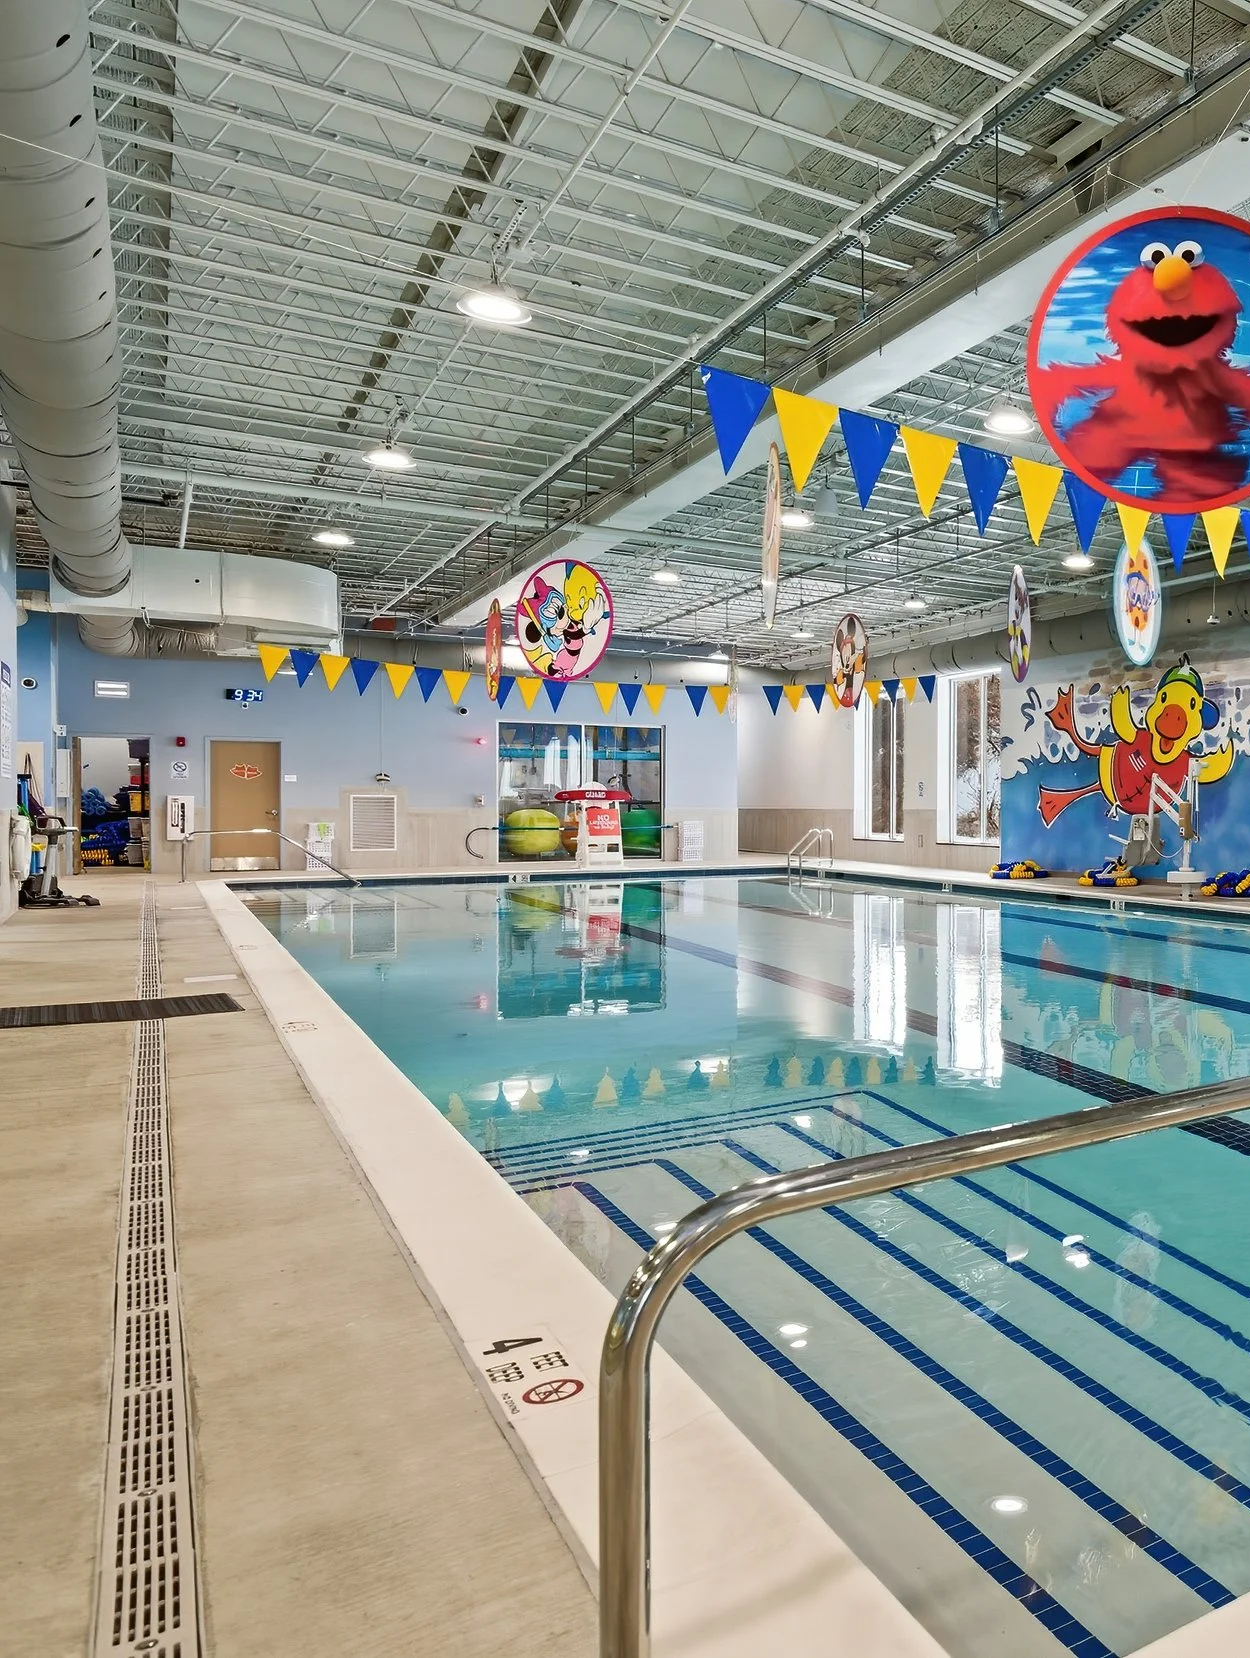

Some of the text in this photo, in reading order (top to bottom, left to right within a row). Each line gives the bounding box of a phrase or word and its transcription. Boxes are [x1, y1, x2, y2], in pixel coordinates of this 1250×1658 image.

[482, 1337, 544, 1356] 4
[485, 1361, 525, 1384] DEEP
[530, 1350, 570, 1373] FEET
